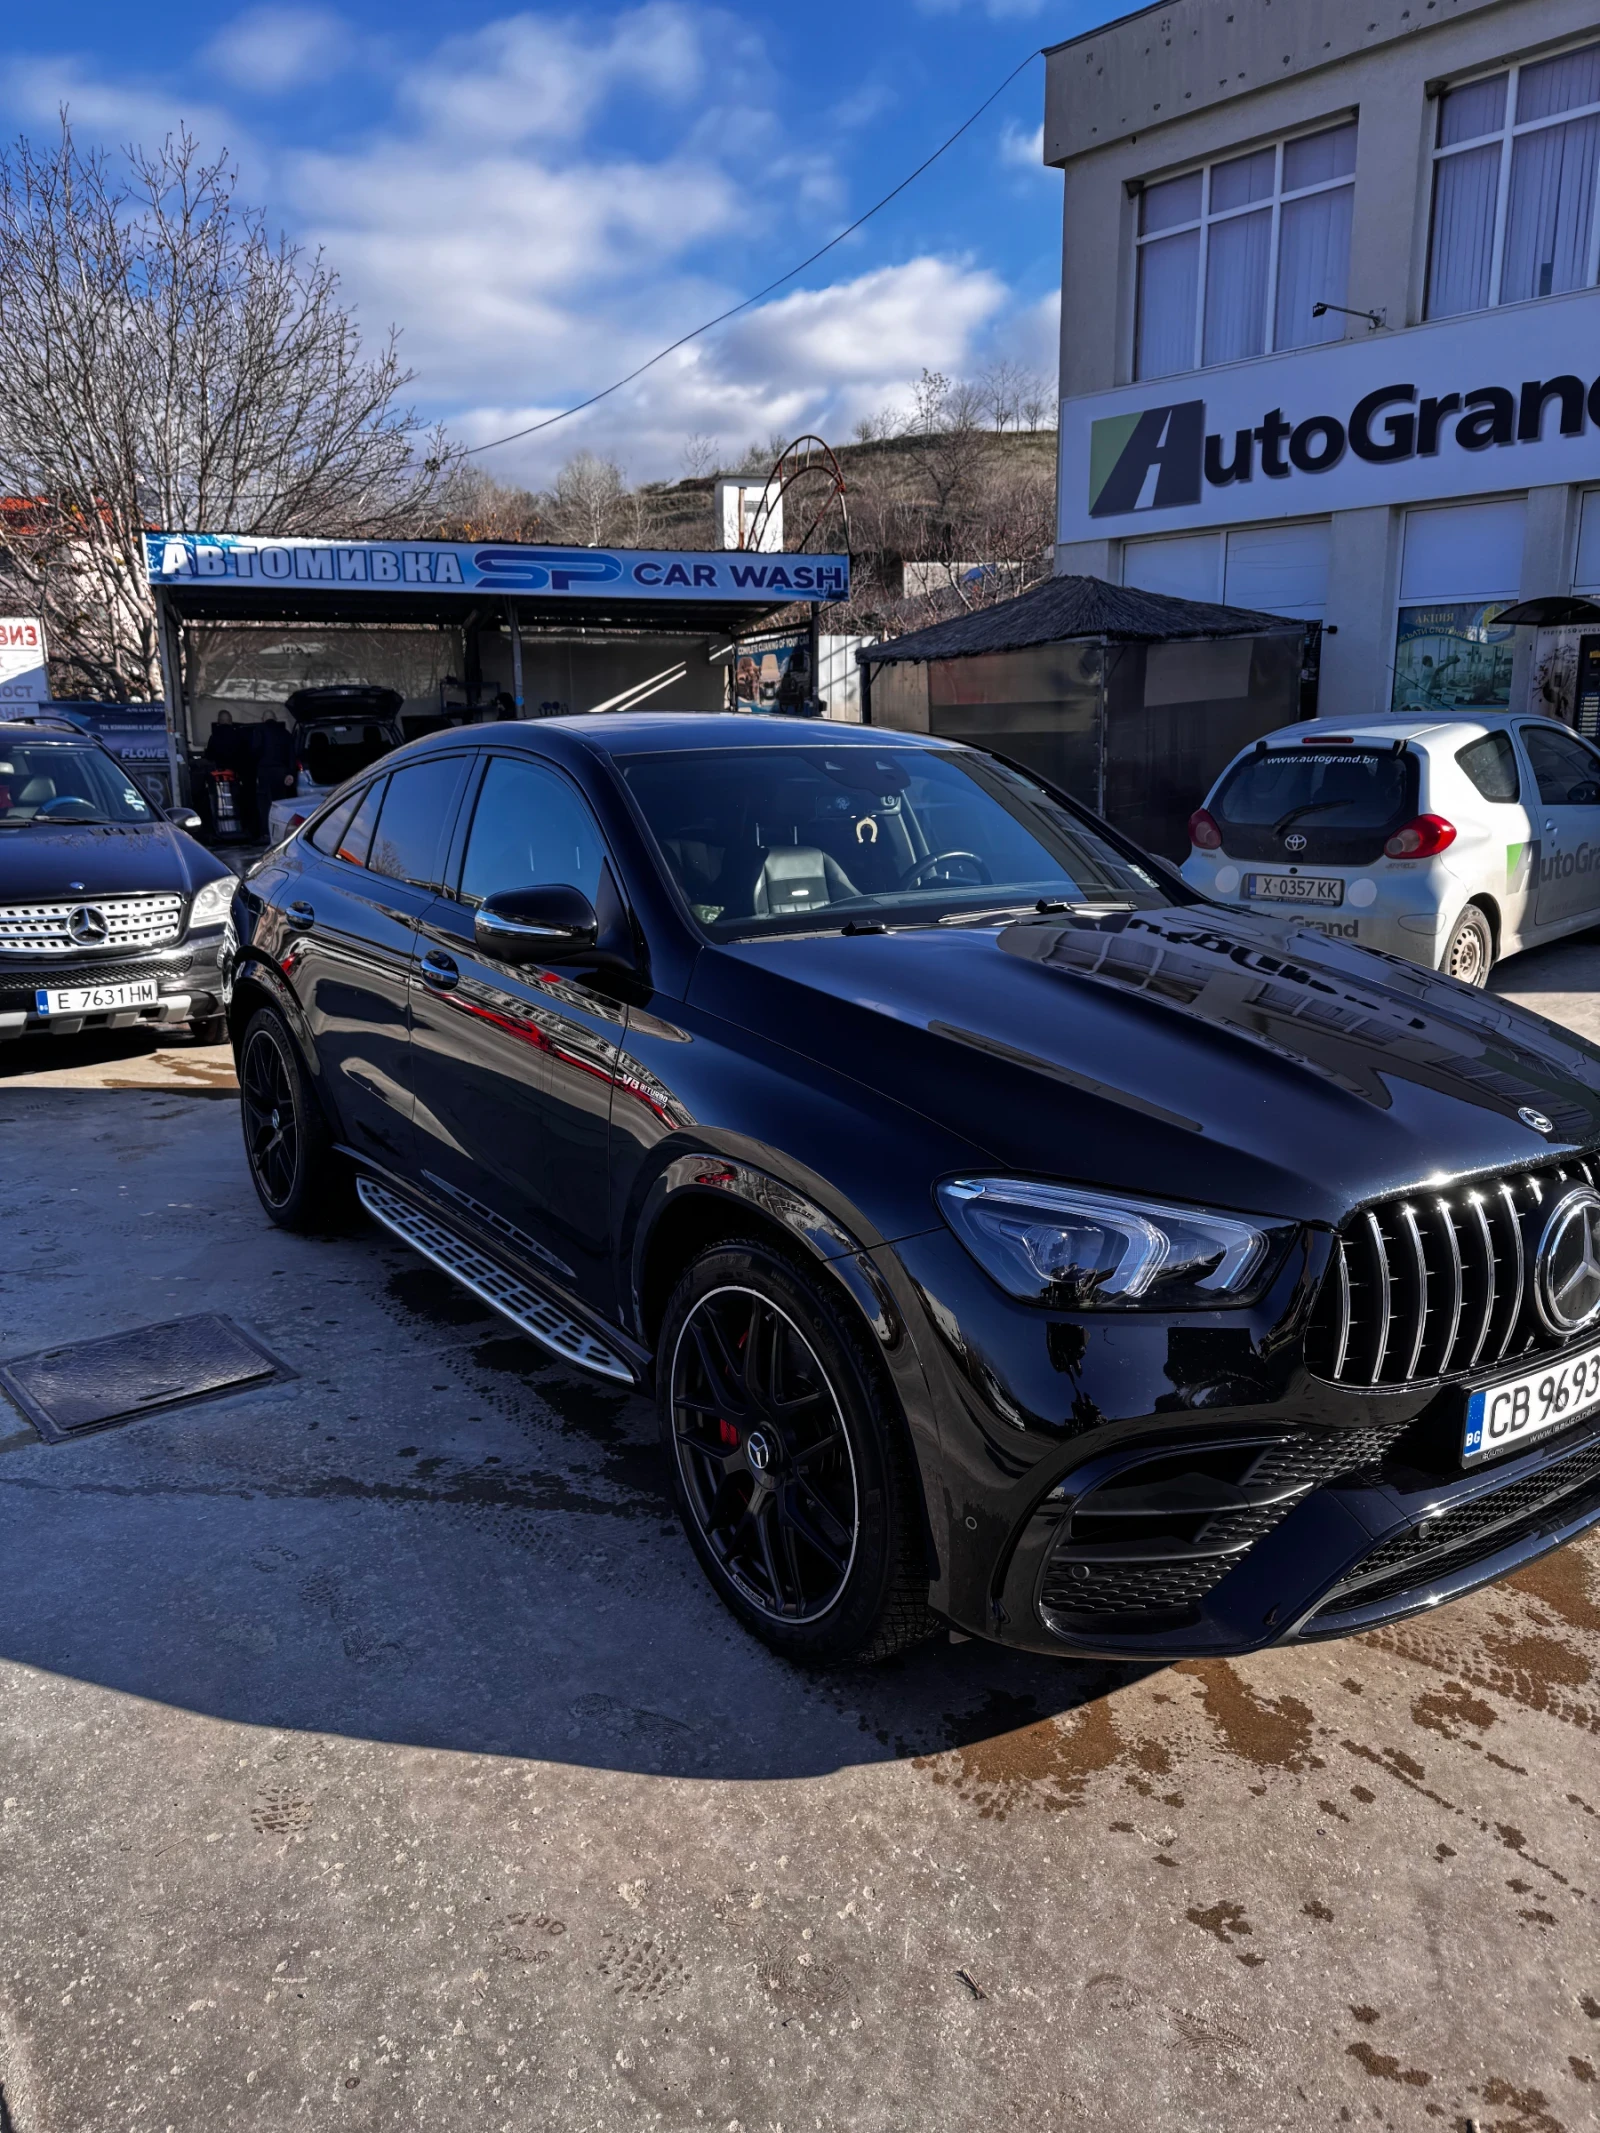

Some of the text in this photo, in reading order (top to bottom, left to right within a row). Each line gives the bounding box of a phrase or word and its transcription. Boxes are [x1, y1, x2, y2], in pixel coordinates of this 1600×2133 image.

[1089, 374, 1600, 516] AutoGran
[161, 542, 466, 584] АВТОМИВКА
[472, 549, 623, 590] SP
[632, 562, 844, 590] CAR WASH
[1415, 613, 1454, 624] АКЦИЯ
[1279, 880, 1316, 897] 0357
[58, 985, 153, 1009] E 7631 HM
[622, 1073, 640, 1090] V8
[640, 1083, 668, 1103] BITURBO
[1489, 1354, 1600, 1439] CB 9693
[1466, 1430, 1481, 1447] BG
